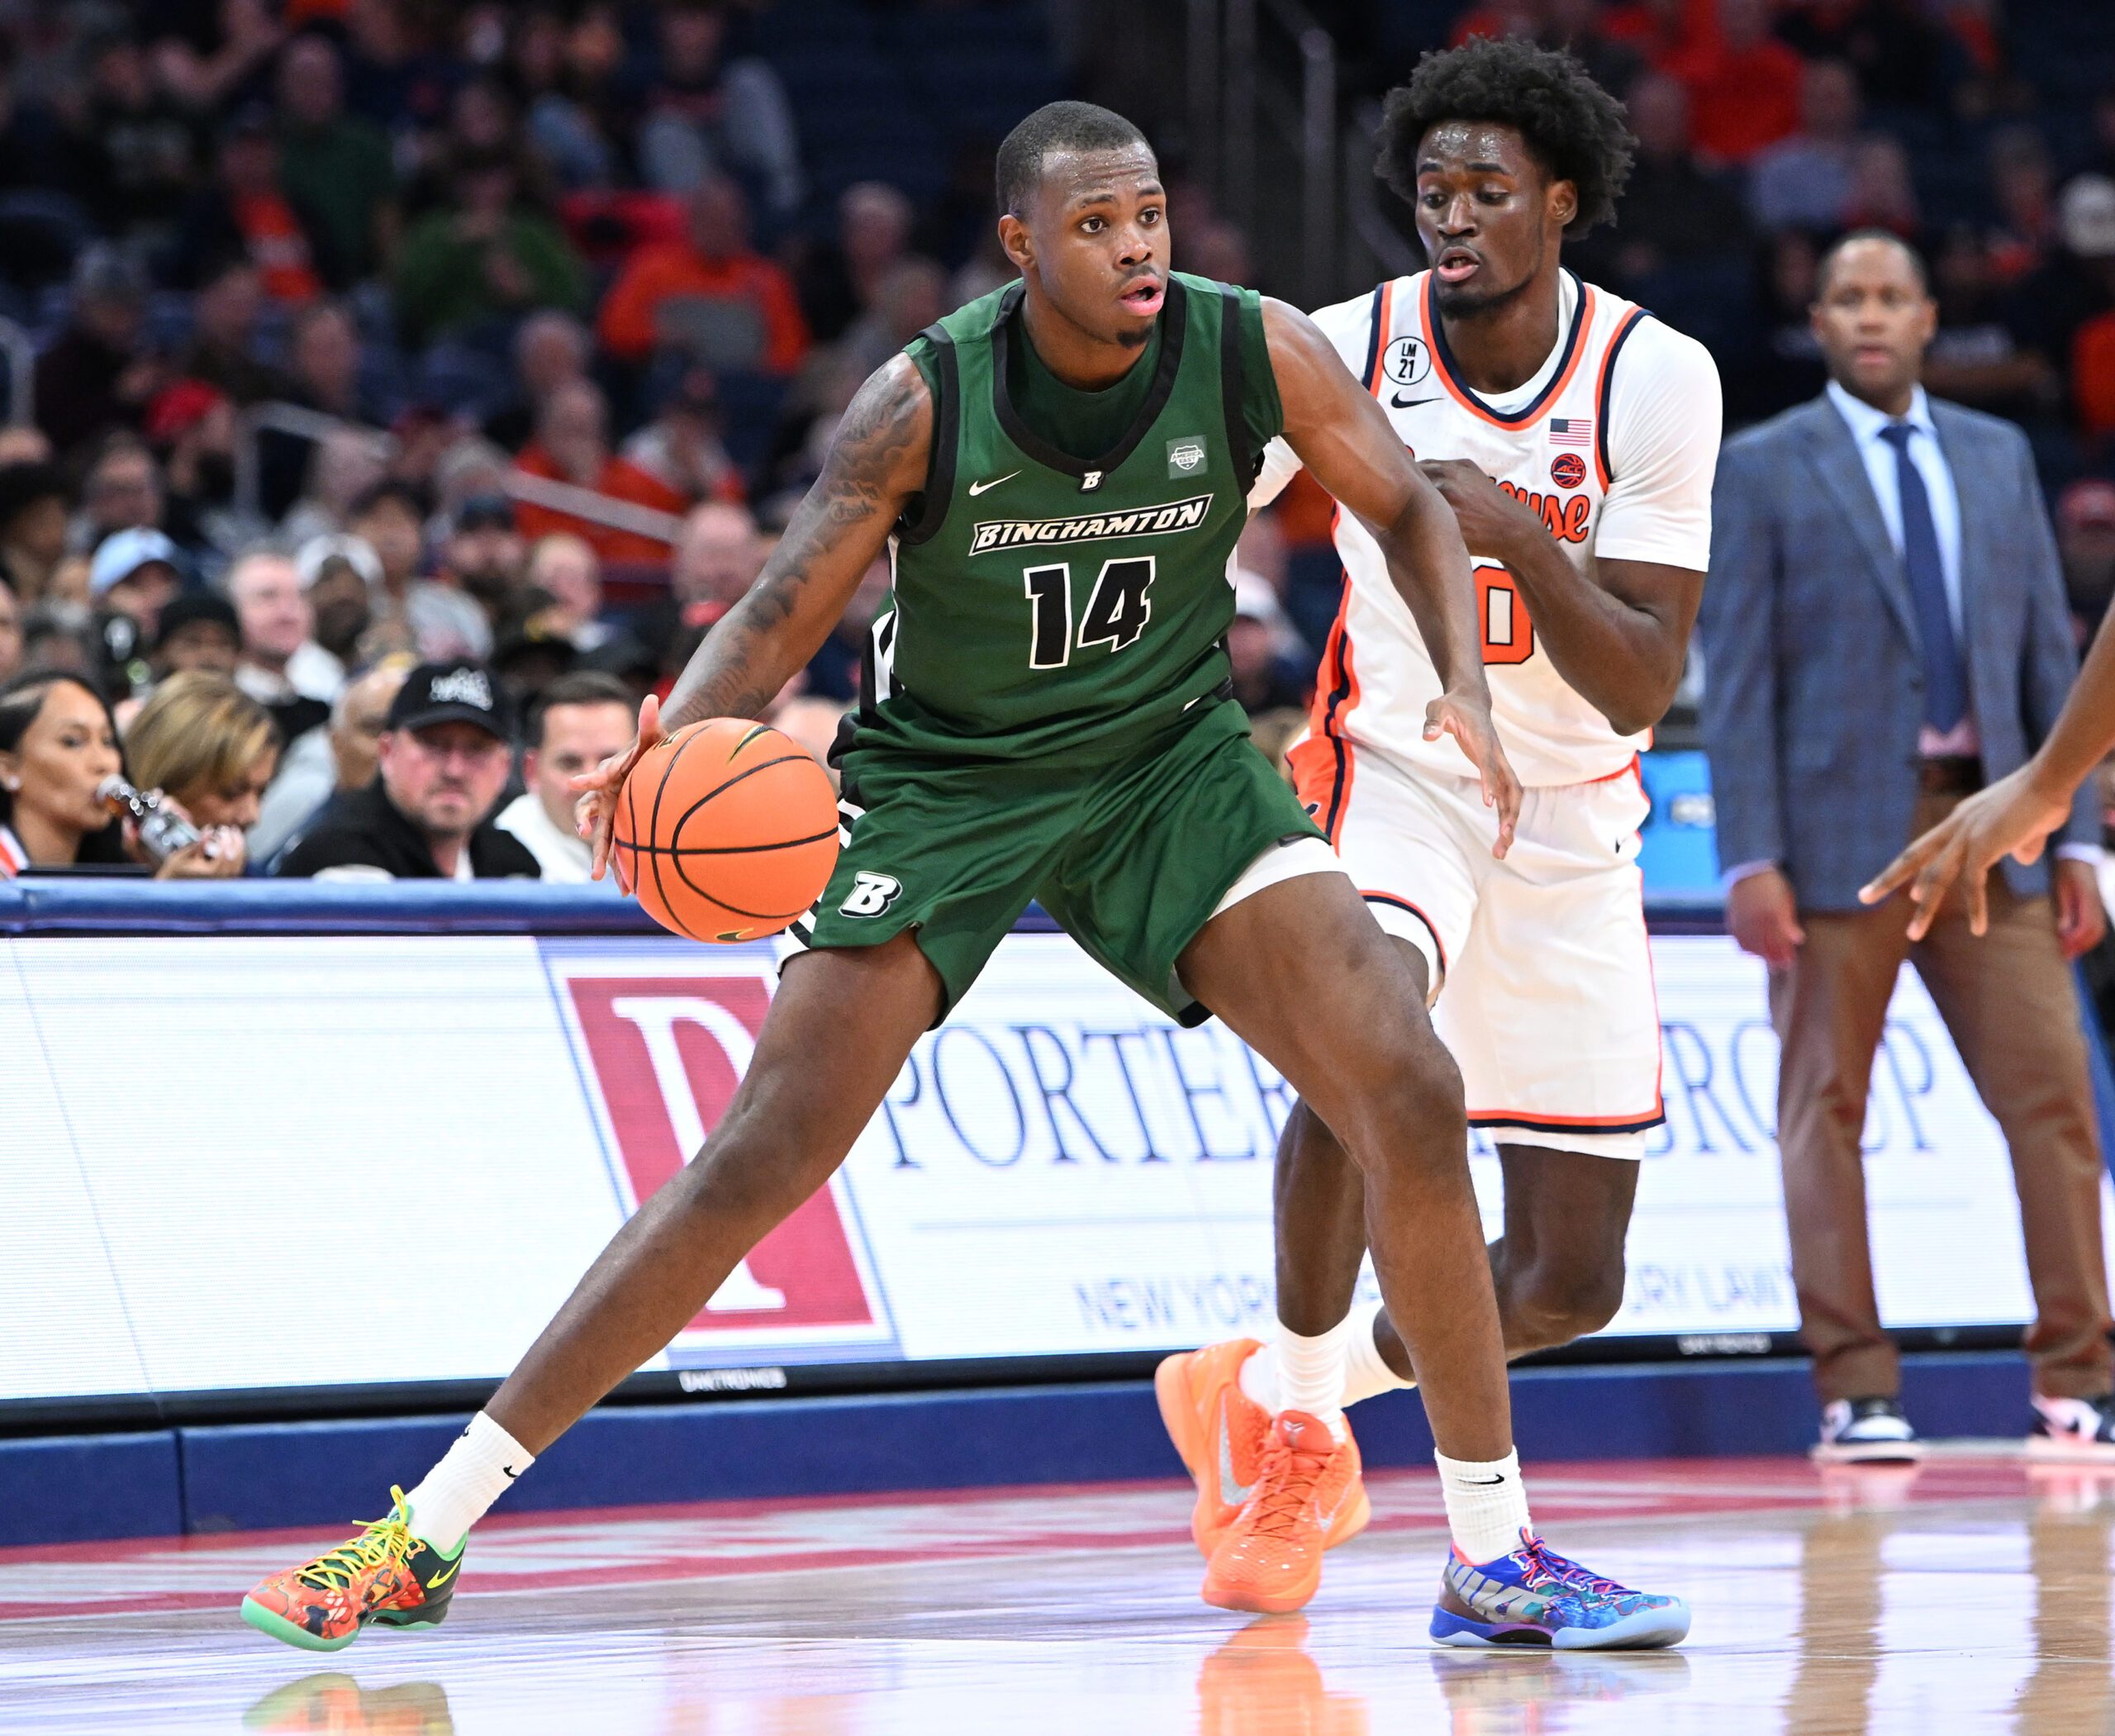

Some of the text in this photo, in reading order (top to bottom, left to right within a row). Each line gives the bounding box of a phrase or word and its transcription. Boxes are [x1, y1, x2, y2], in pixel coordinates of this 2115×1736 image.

[1401, 343, 1417, 357] LM
[1398, 358, 1415, 379] 21
[1081, 471, 1101, 490] B
[1556, 464, 1583, 474] ACC
[976, 501, 1205, 549] BINGHAMTON
[1024, 555, 1156, 669] 14
[839, 871, 902, 918] B
[1074, 1274, 1175, 1332] NEW
[1180, 1272, 1275, 1327] YOR
